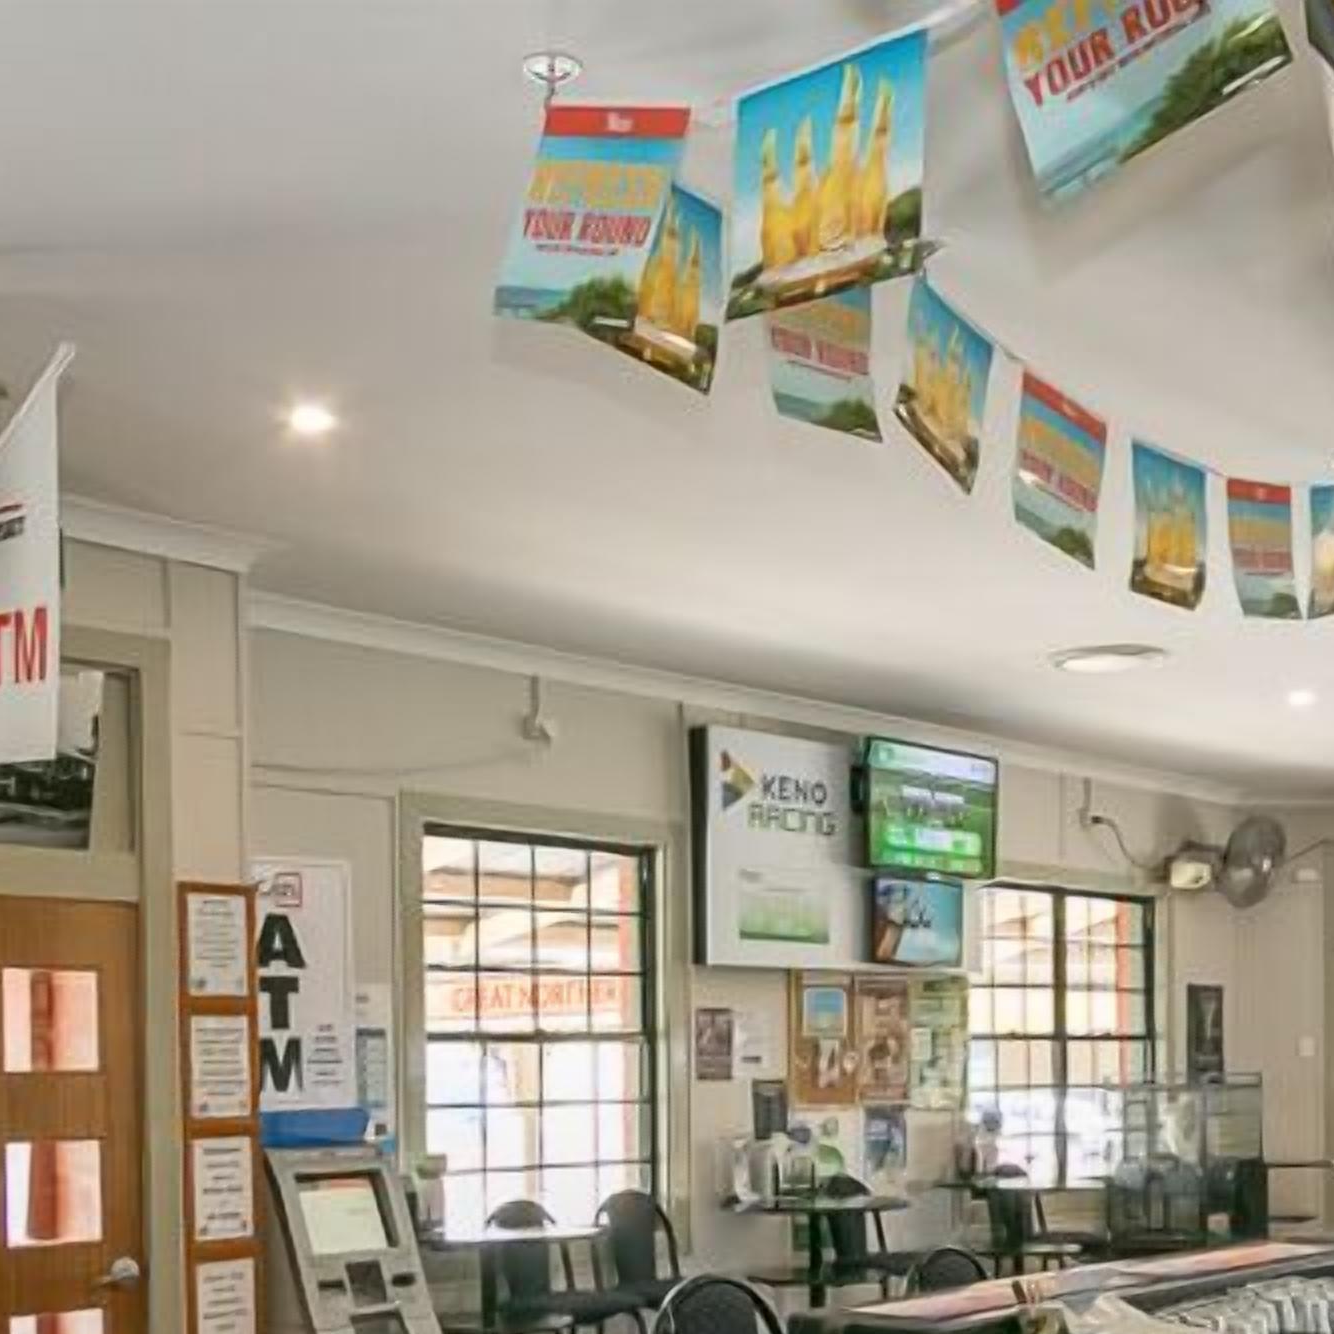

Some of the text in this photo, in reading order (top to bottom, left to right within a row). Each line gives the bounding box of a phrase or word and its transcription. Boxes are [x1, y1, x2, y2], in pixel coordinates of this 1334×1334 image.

[1023, 28, 1115, 106] YOUR
[523, 208, 652, 248] YOUR ROUND
[761, 773, 828, 807] KENO
[257, 912, 306, 1093] ATM
